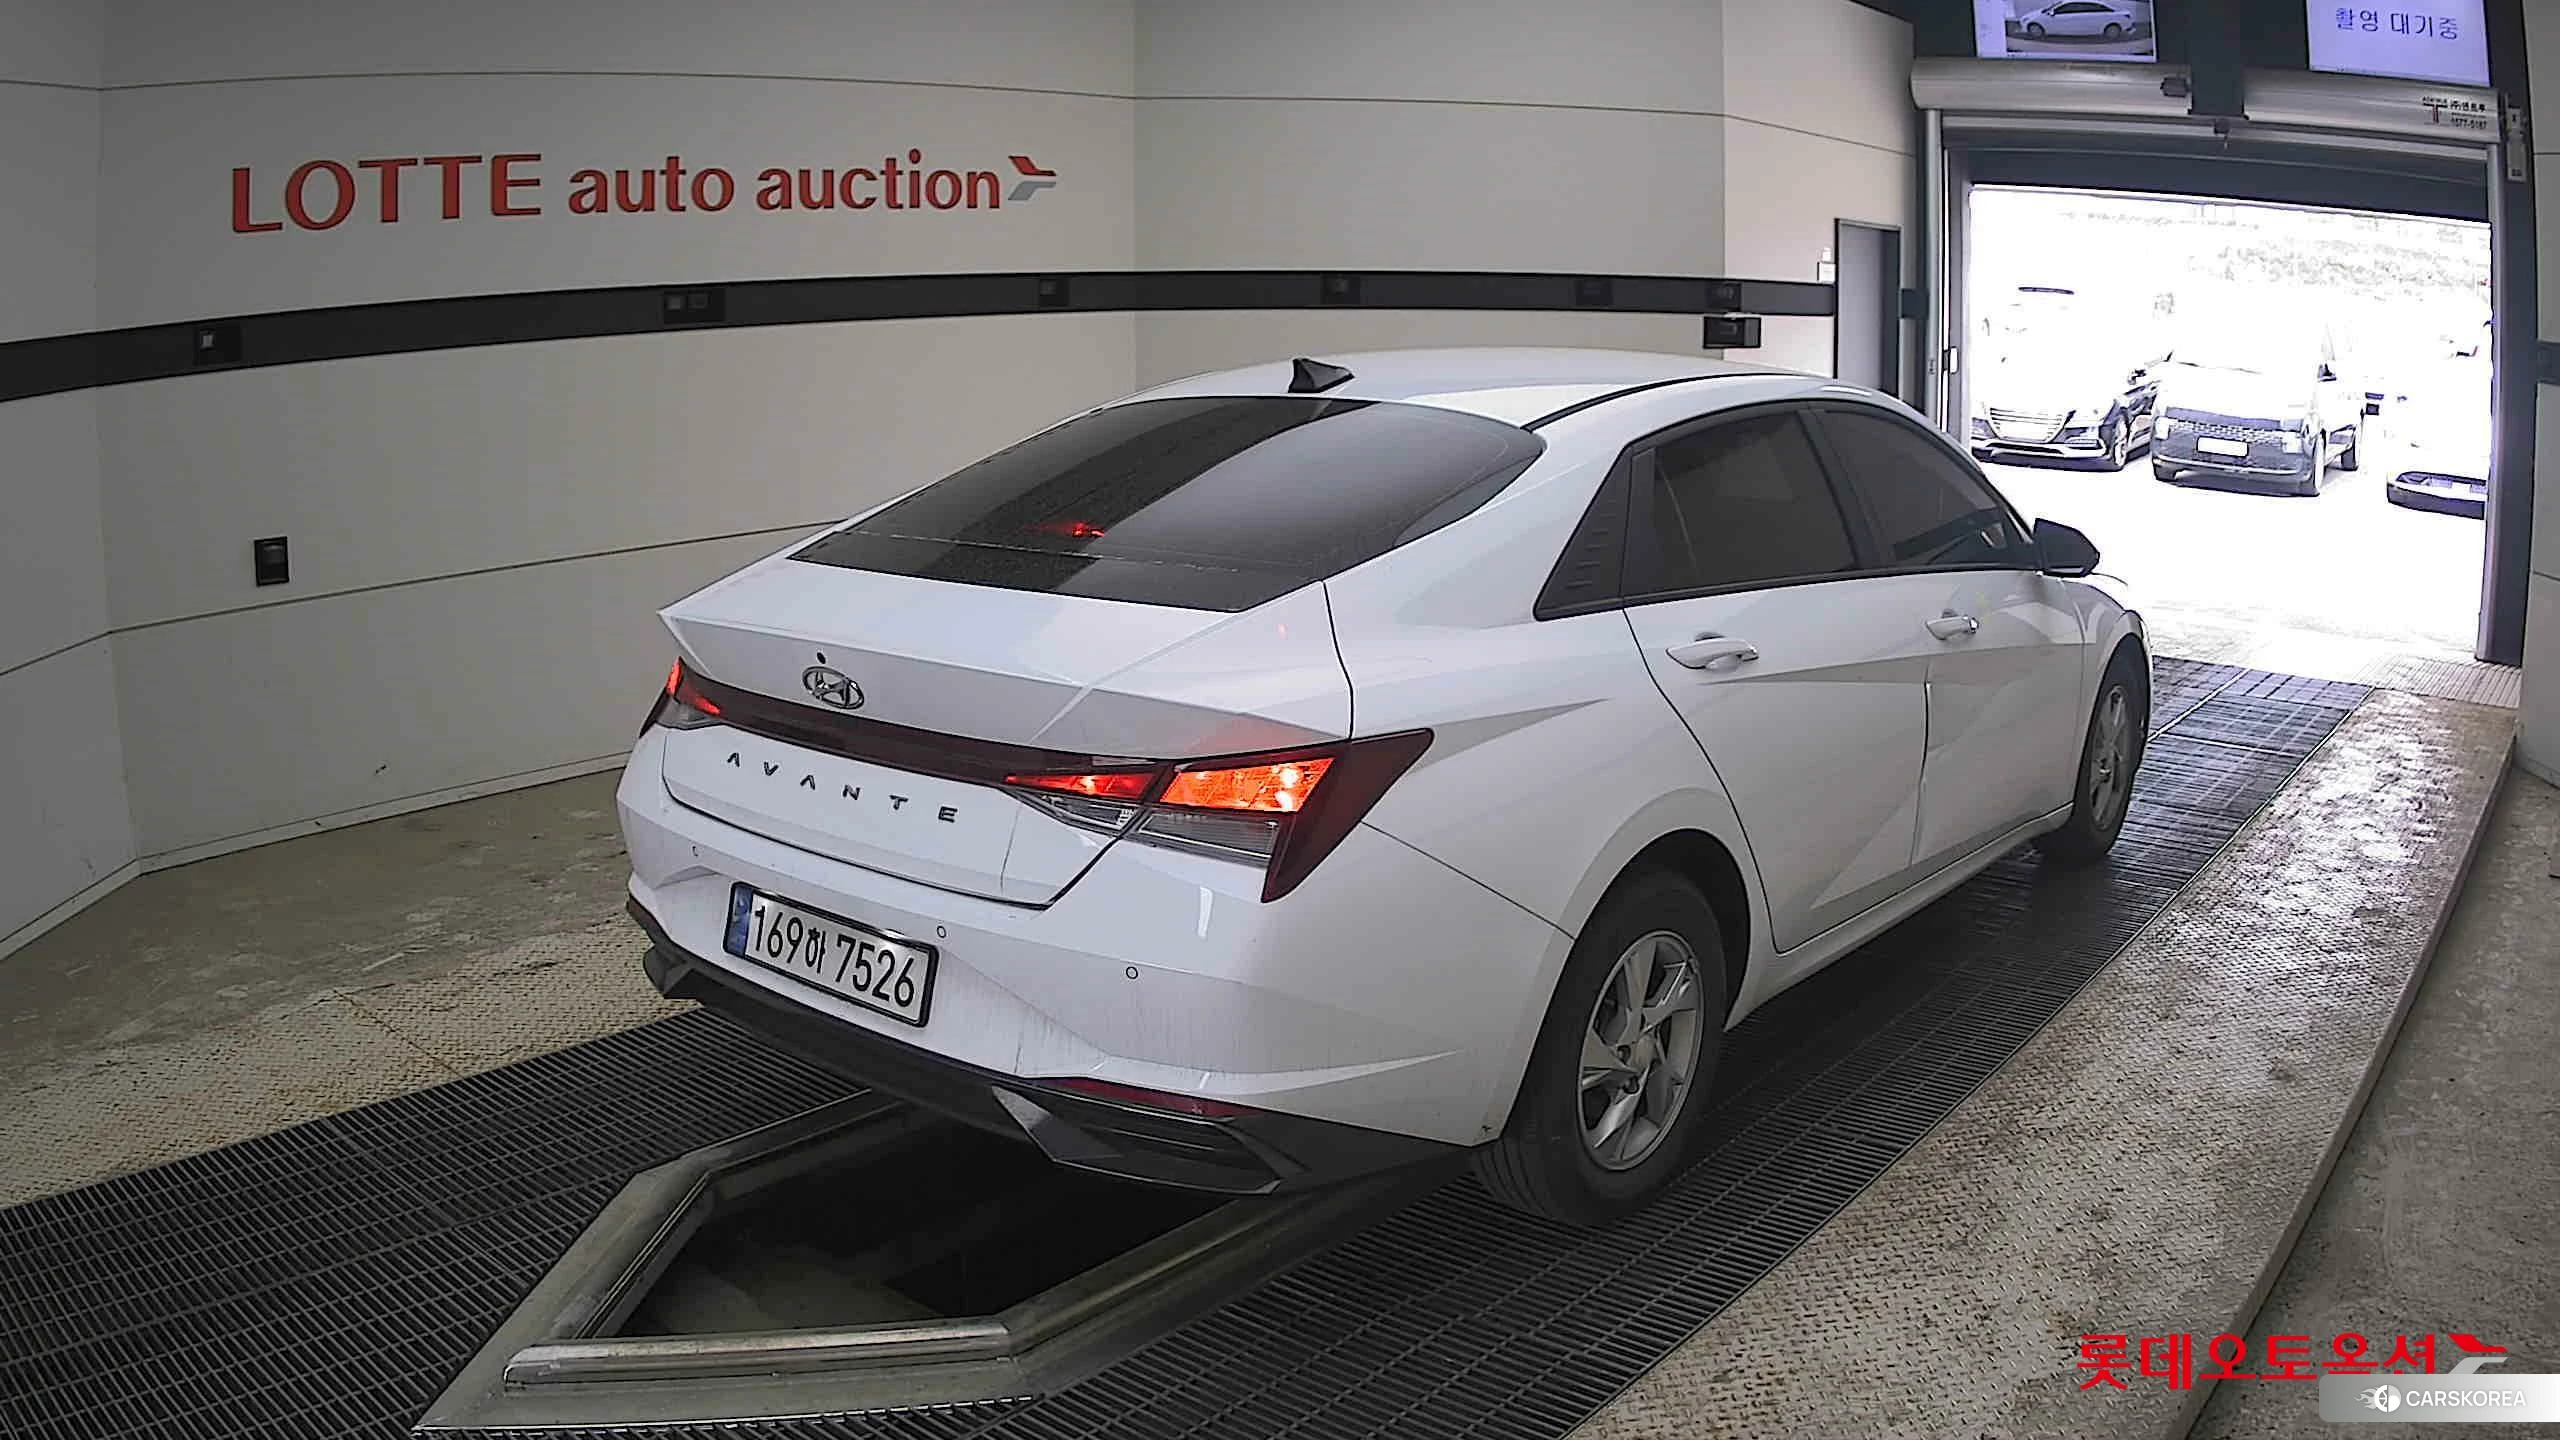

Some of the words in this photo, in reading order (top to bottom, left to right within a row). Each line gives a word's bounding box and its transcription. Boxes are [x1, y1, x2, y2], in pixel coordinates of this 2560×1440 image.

[2335, 7, 2379, 32] 촬영
[2390, 12, 2458, 40] 대기중
[231, 153, 542, 233] LOTTE
[567, 155, 735, 215] auto
[755, 148, 1001, 212] auction
[727, 751, 958, 823] AVANTE
[754, 905, 827, 975] 169하
[835, 934, 915, 1008] 7526
